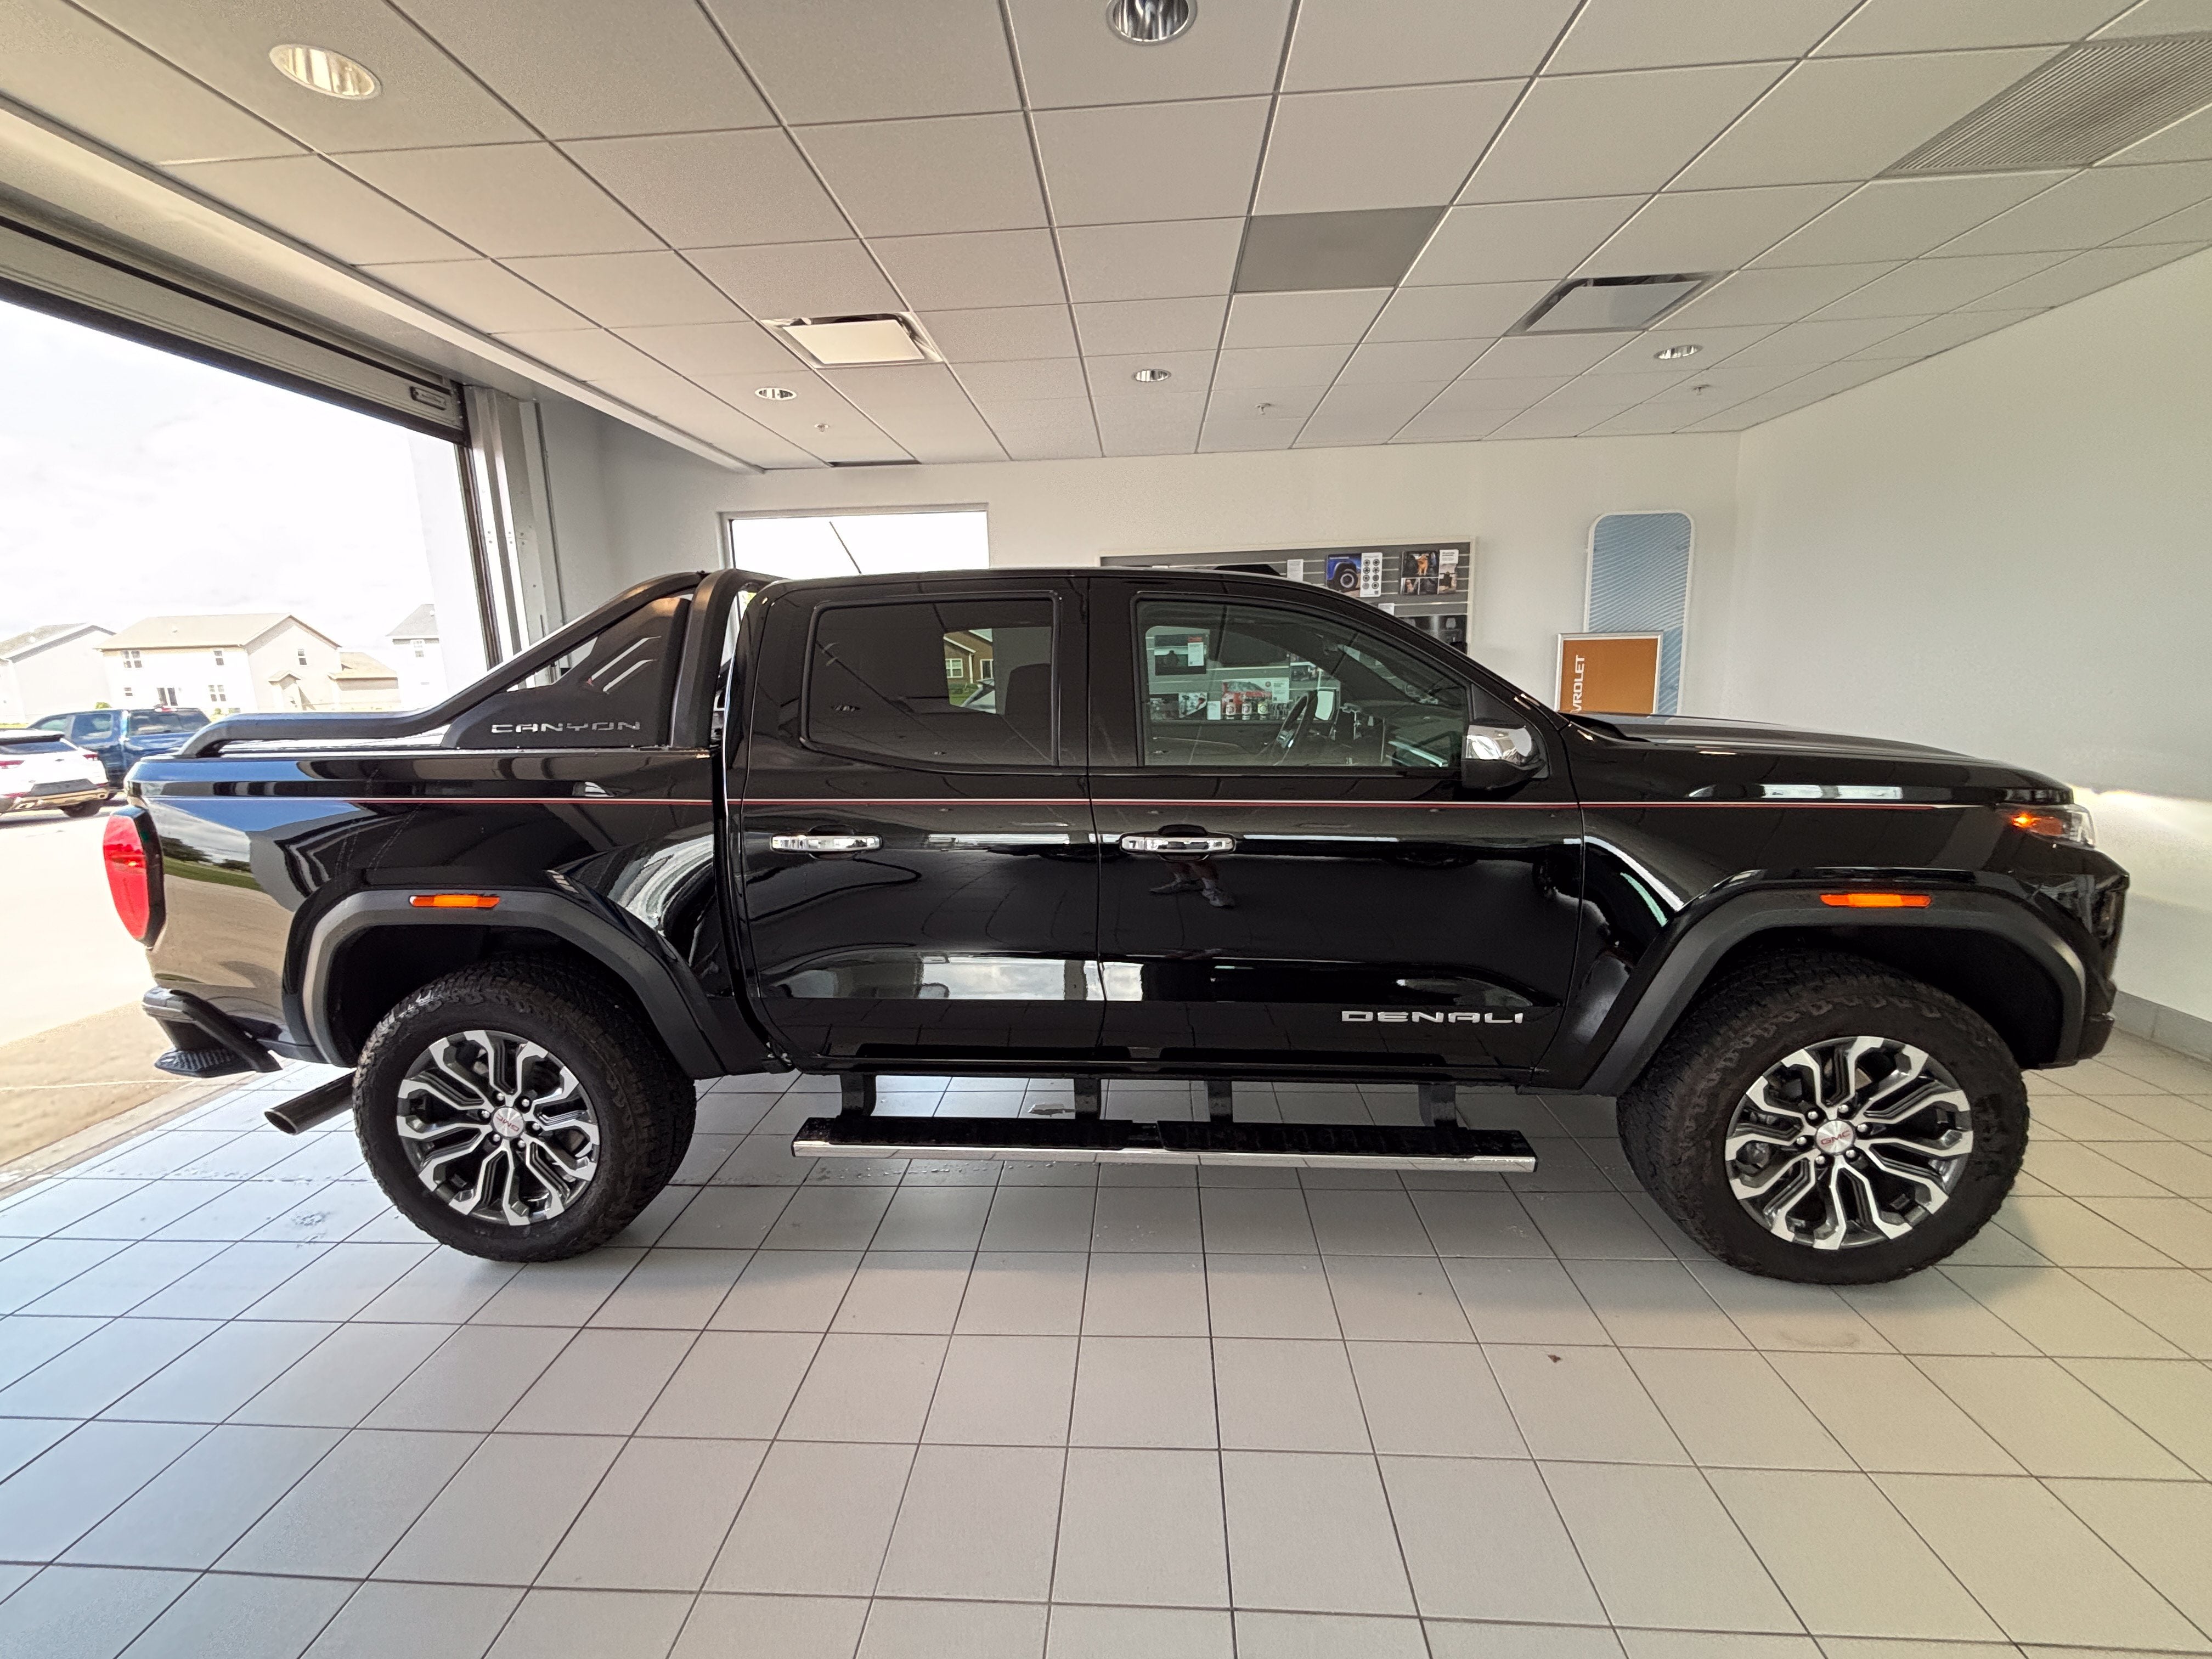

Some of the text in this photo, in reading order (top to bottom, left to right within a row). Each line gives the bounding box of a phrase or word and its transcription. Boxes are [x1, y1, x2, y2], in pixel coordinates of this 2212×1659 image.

[491, 721, 641, 733] CANYON
[1341, 1011, 1523, 1024] DENALI
[495, 1113, 520, 1132] GMC
[1820, 1129, 1851, 1145] GMC
